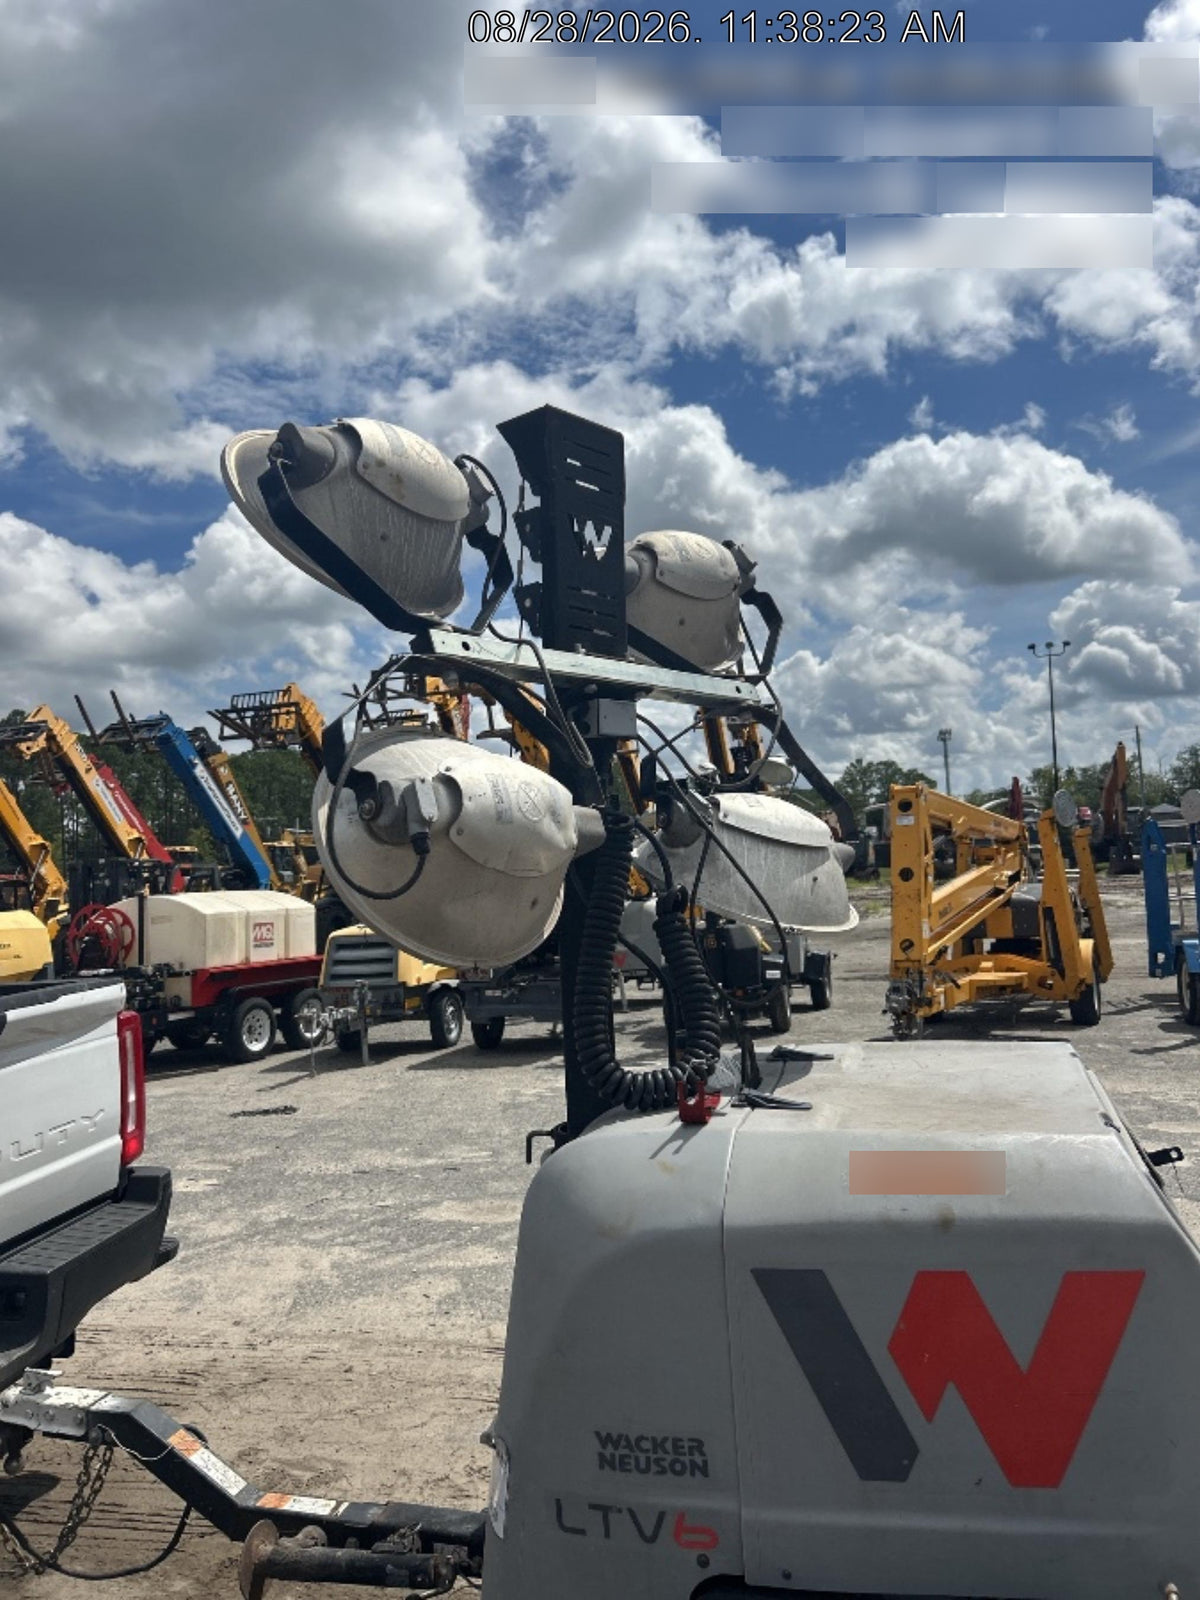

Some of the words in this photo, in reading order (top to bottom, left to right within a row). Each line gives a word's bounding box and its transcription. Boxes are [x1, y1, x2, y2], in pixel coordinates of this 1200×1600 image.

[0, 1108, 105, 1162] UTY
[593, 1430, 707, 1457] WACKER
[597, 1452, 710, 1478] NEUSON
[555, 1498, 720, 1551] LTV6
